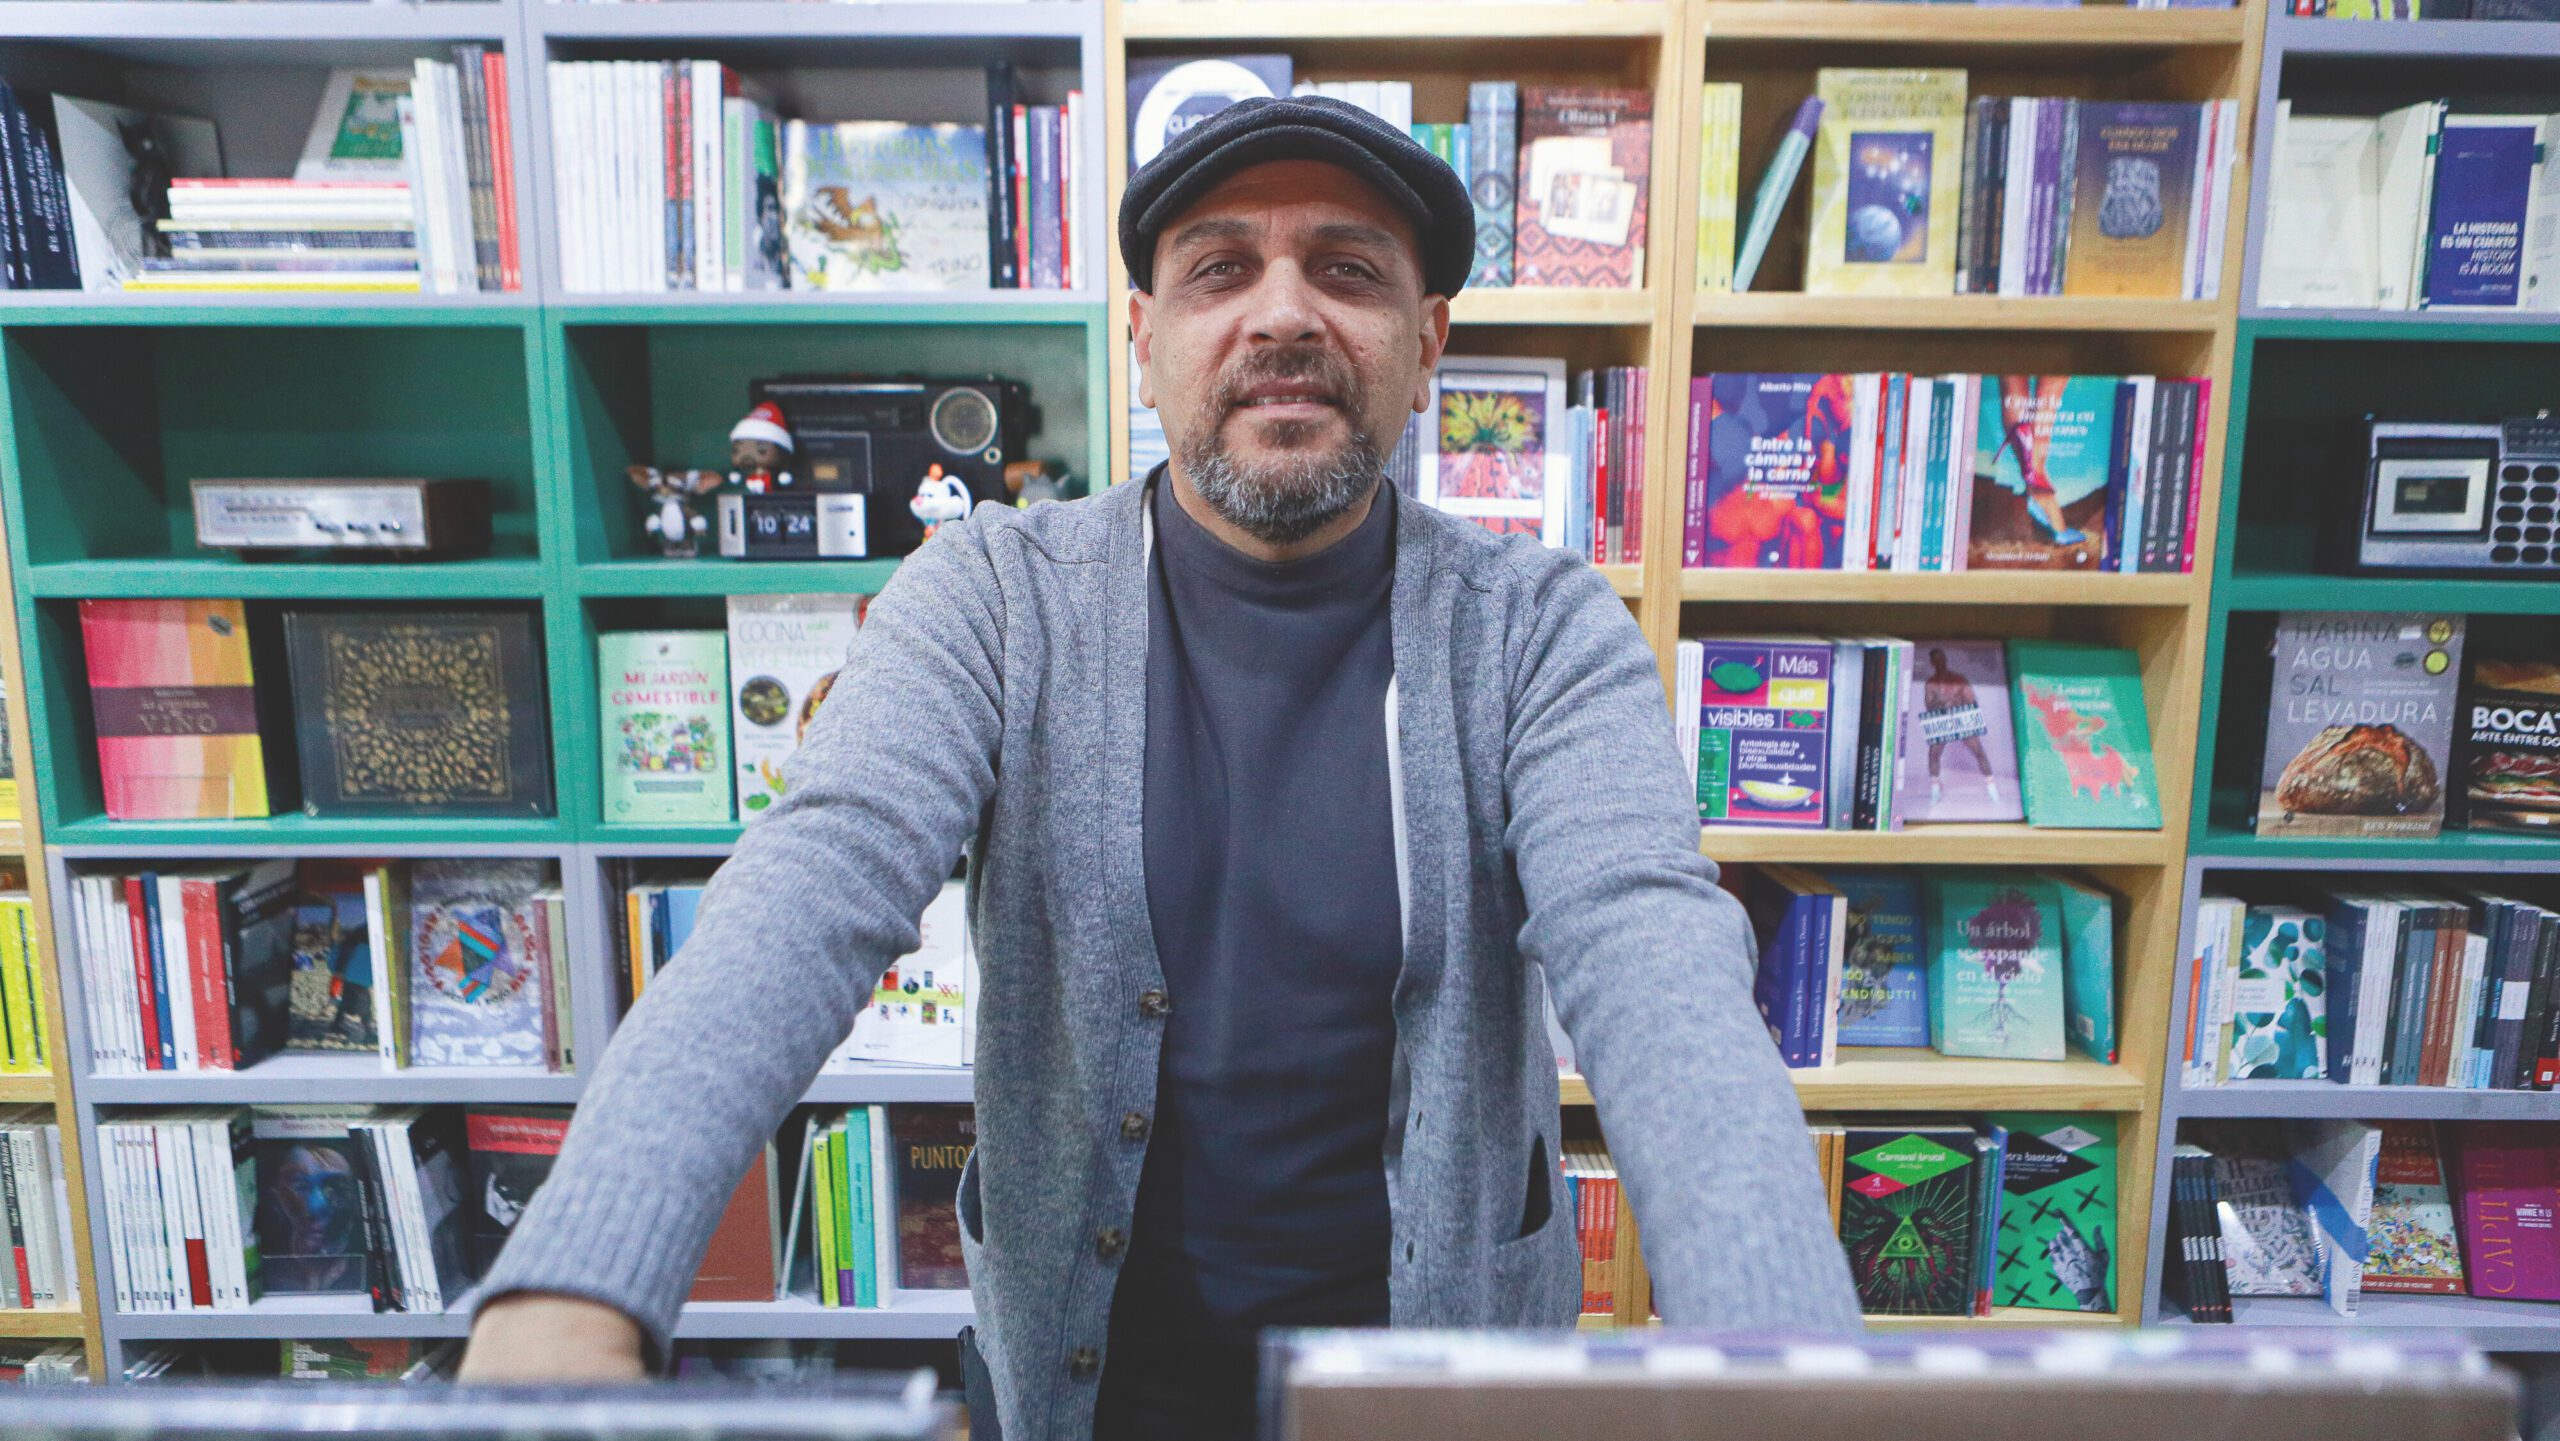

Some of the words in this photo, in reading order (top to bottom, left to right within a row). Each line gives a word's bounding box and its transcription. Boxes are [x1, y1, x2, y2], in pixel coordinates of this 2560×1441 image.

[2453, 222, 2468, 235] LA
[2468, 222, 2519, 235] HISTORIA
[2455, 235, 2473, 249] UN
[2472, 235, 2518, 249] CUARTO
[2470, 249, 2517, 262] HISTORY
[2470, 262, 2479, 275] A
[2478, 262, 2516, 276] ROOM
[1759, 382, 1792, 392] Alberto
[1793, 382, 1812, 392] Mira
[1751, 436, 1794, 452] Entre
[1796, 436, 1812, 452] la
[1744, 452, 1802, 467] cámara
[1806, 455, 1816, 469] y
[1748, 466, 1763, 481] la
[1766, 468, 1811, 482] carne
[757, 515, 777, 534] 10
[787, 514, 811, 534] 24
[2294, 621, 2399, 643] HARINA
[1779, 655, 1819, 675] Más
[2292, 646, 2373, 671] AGUA
[623, 671, 646, 685] MI
[2289, 673, 2342, 697] SAL
[611, 689, 720, 706] COMESTIBLE
[1779, 686, 1816, 704] que
[1708, 708, 1775, 728] visibles
[2287, 699, 2439, 724] LEVADURA
[2471, 732, 2501, 743] ARTE
[2503, 734, 2540, 746] ENTRE
[1957, 920, 1981, 937] Un
[1985, 920, 2031, 938] árbol
[1906, 971, 1917, 981] A
[1956, 970, 1976, 981] en
[1982, 968, 1996, 982] el
